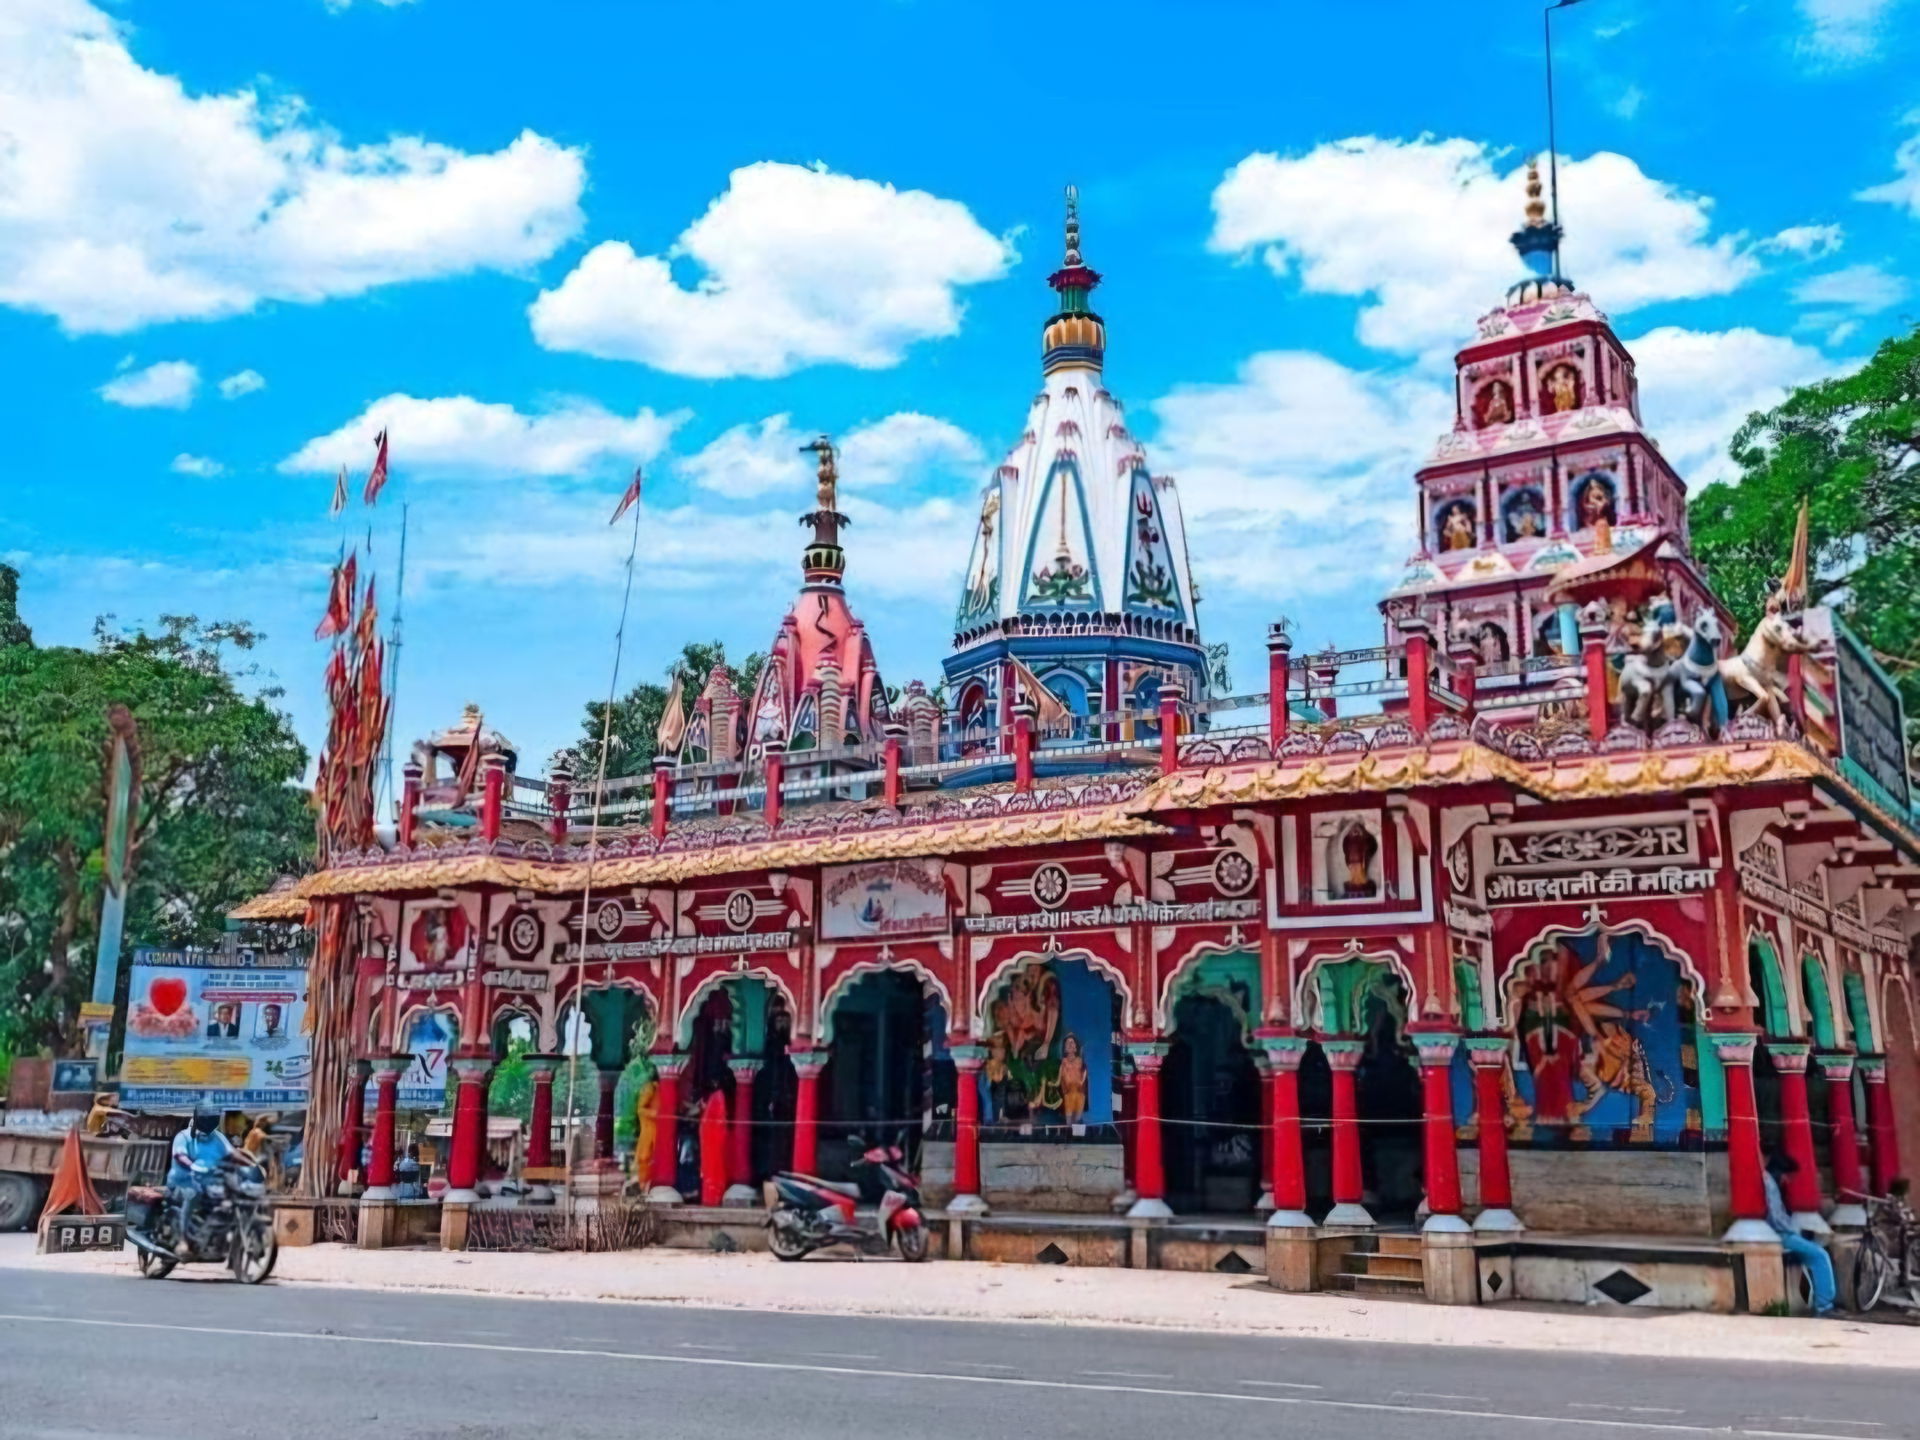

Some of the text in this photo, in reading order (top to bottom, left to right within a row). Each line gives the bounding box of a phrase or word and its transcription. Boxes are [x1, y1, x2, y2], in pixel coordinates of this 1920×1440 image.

[1497, 827, 1686, 865] A R
[1599, 867, 1635, 893] की
[1638, 865, 1719, 897] महिमा
